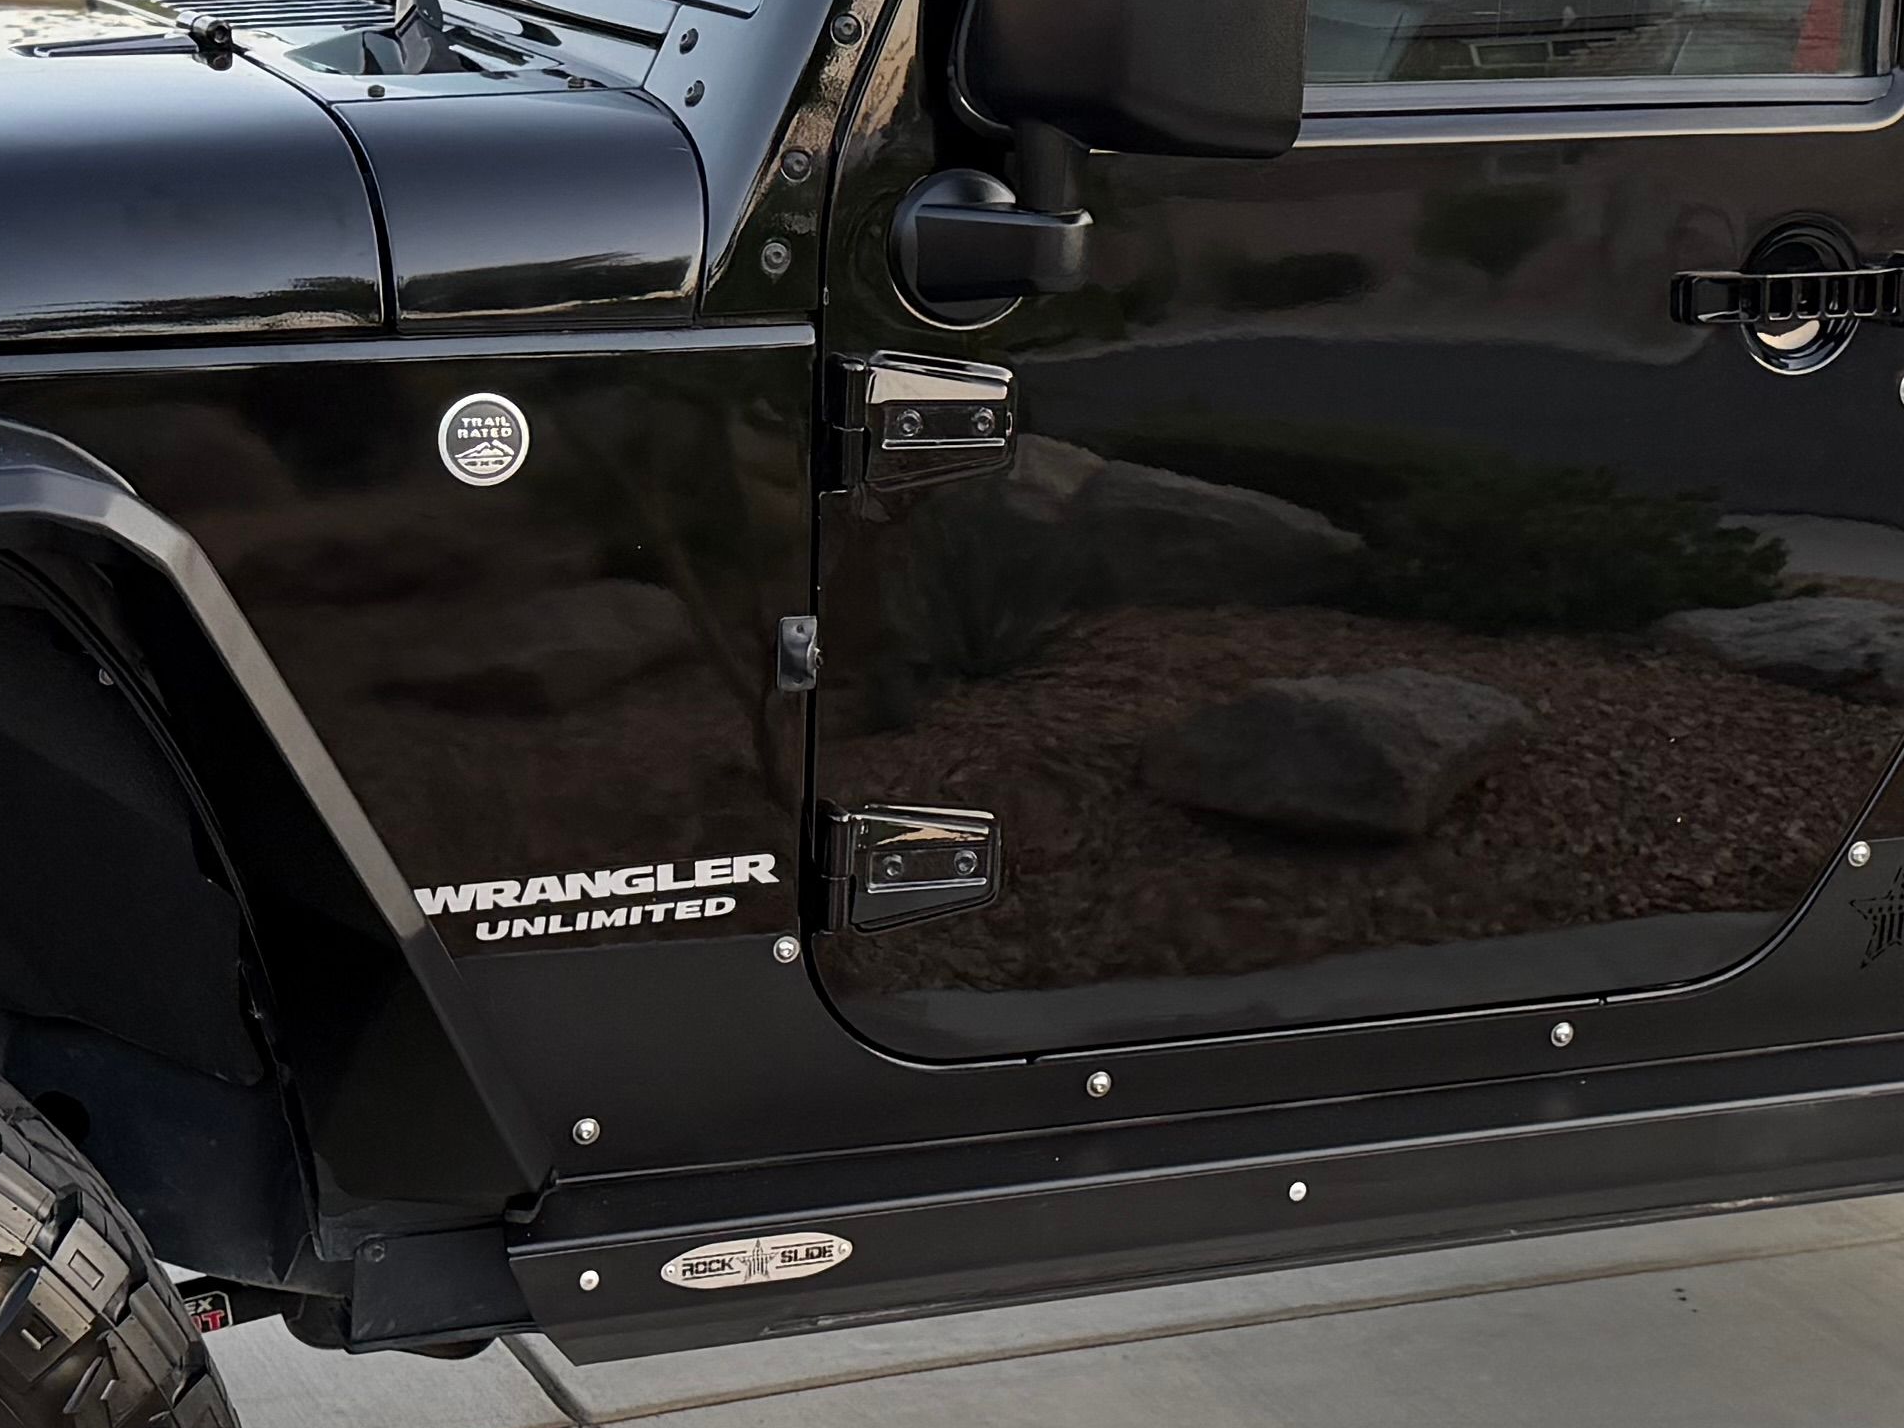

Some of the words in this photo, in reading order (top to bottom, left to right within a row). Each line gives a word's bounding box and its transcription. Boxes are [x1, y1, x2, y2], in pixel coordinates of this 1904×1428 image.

[457, 428, 512, 439] RATED
[461, 416, 511, 428] TRAIL
[415, 853, 780, 915] WRANGLER
[476, 896, 736, 941] UNLIMITED
[681, 1256, 734, 1277] ROCK
[781, 1245, 834, 1264] SLIDE
